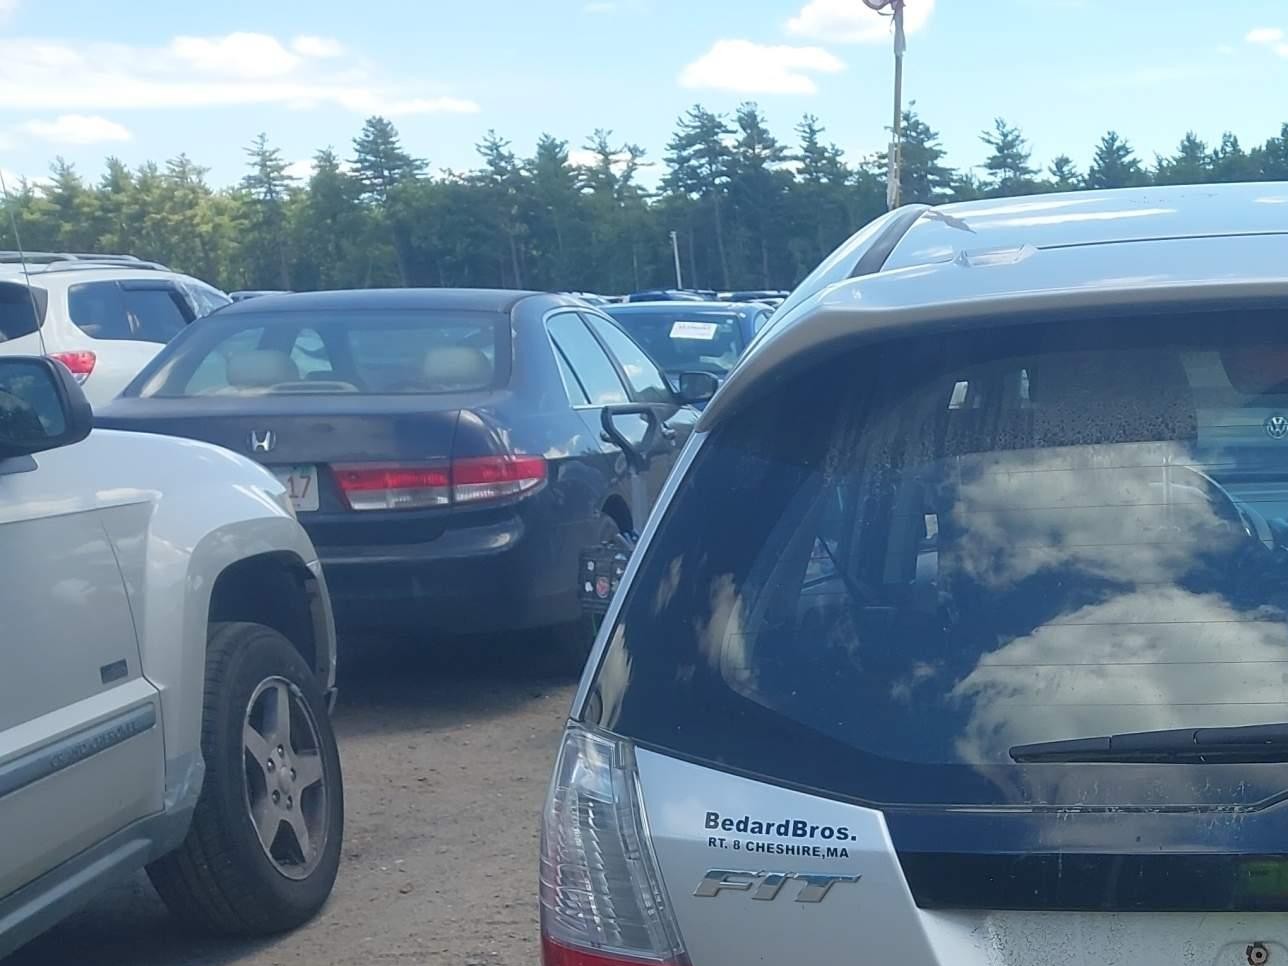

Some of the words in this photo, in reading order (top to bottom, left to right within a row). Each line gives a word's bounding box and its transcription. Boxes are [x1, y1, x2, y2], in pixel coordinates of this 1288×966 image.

[704, 811, 857, 842] BedardBros.
[708, 836, 729, 850] RT.
[732, 839, 742, 851] 8
[745, 840, 850, 860] CHESHIRE,MA
[692, 868, 863, 904] FIT
